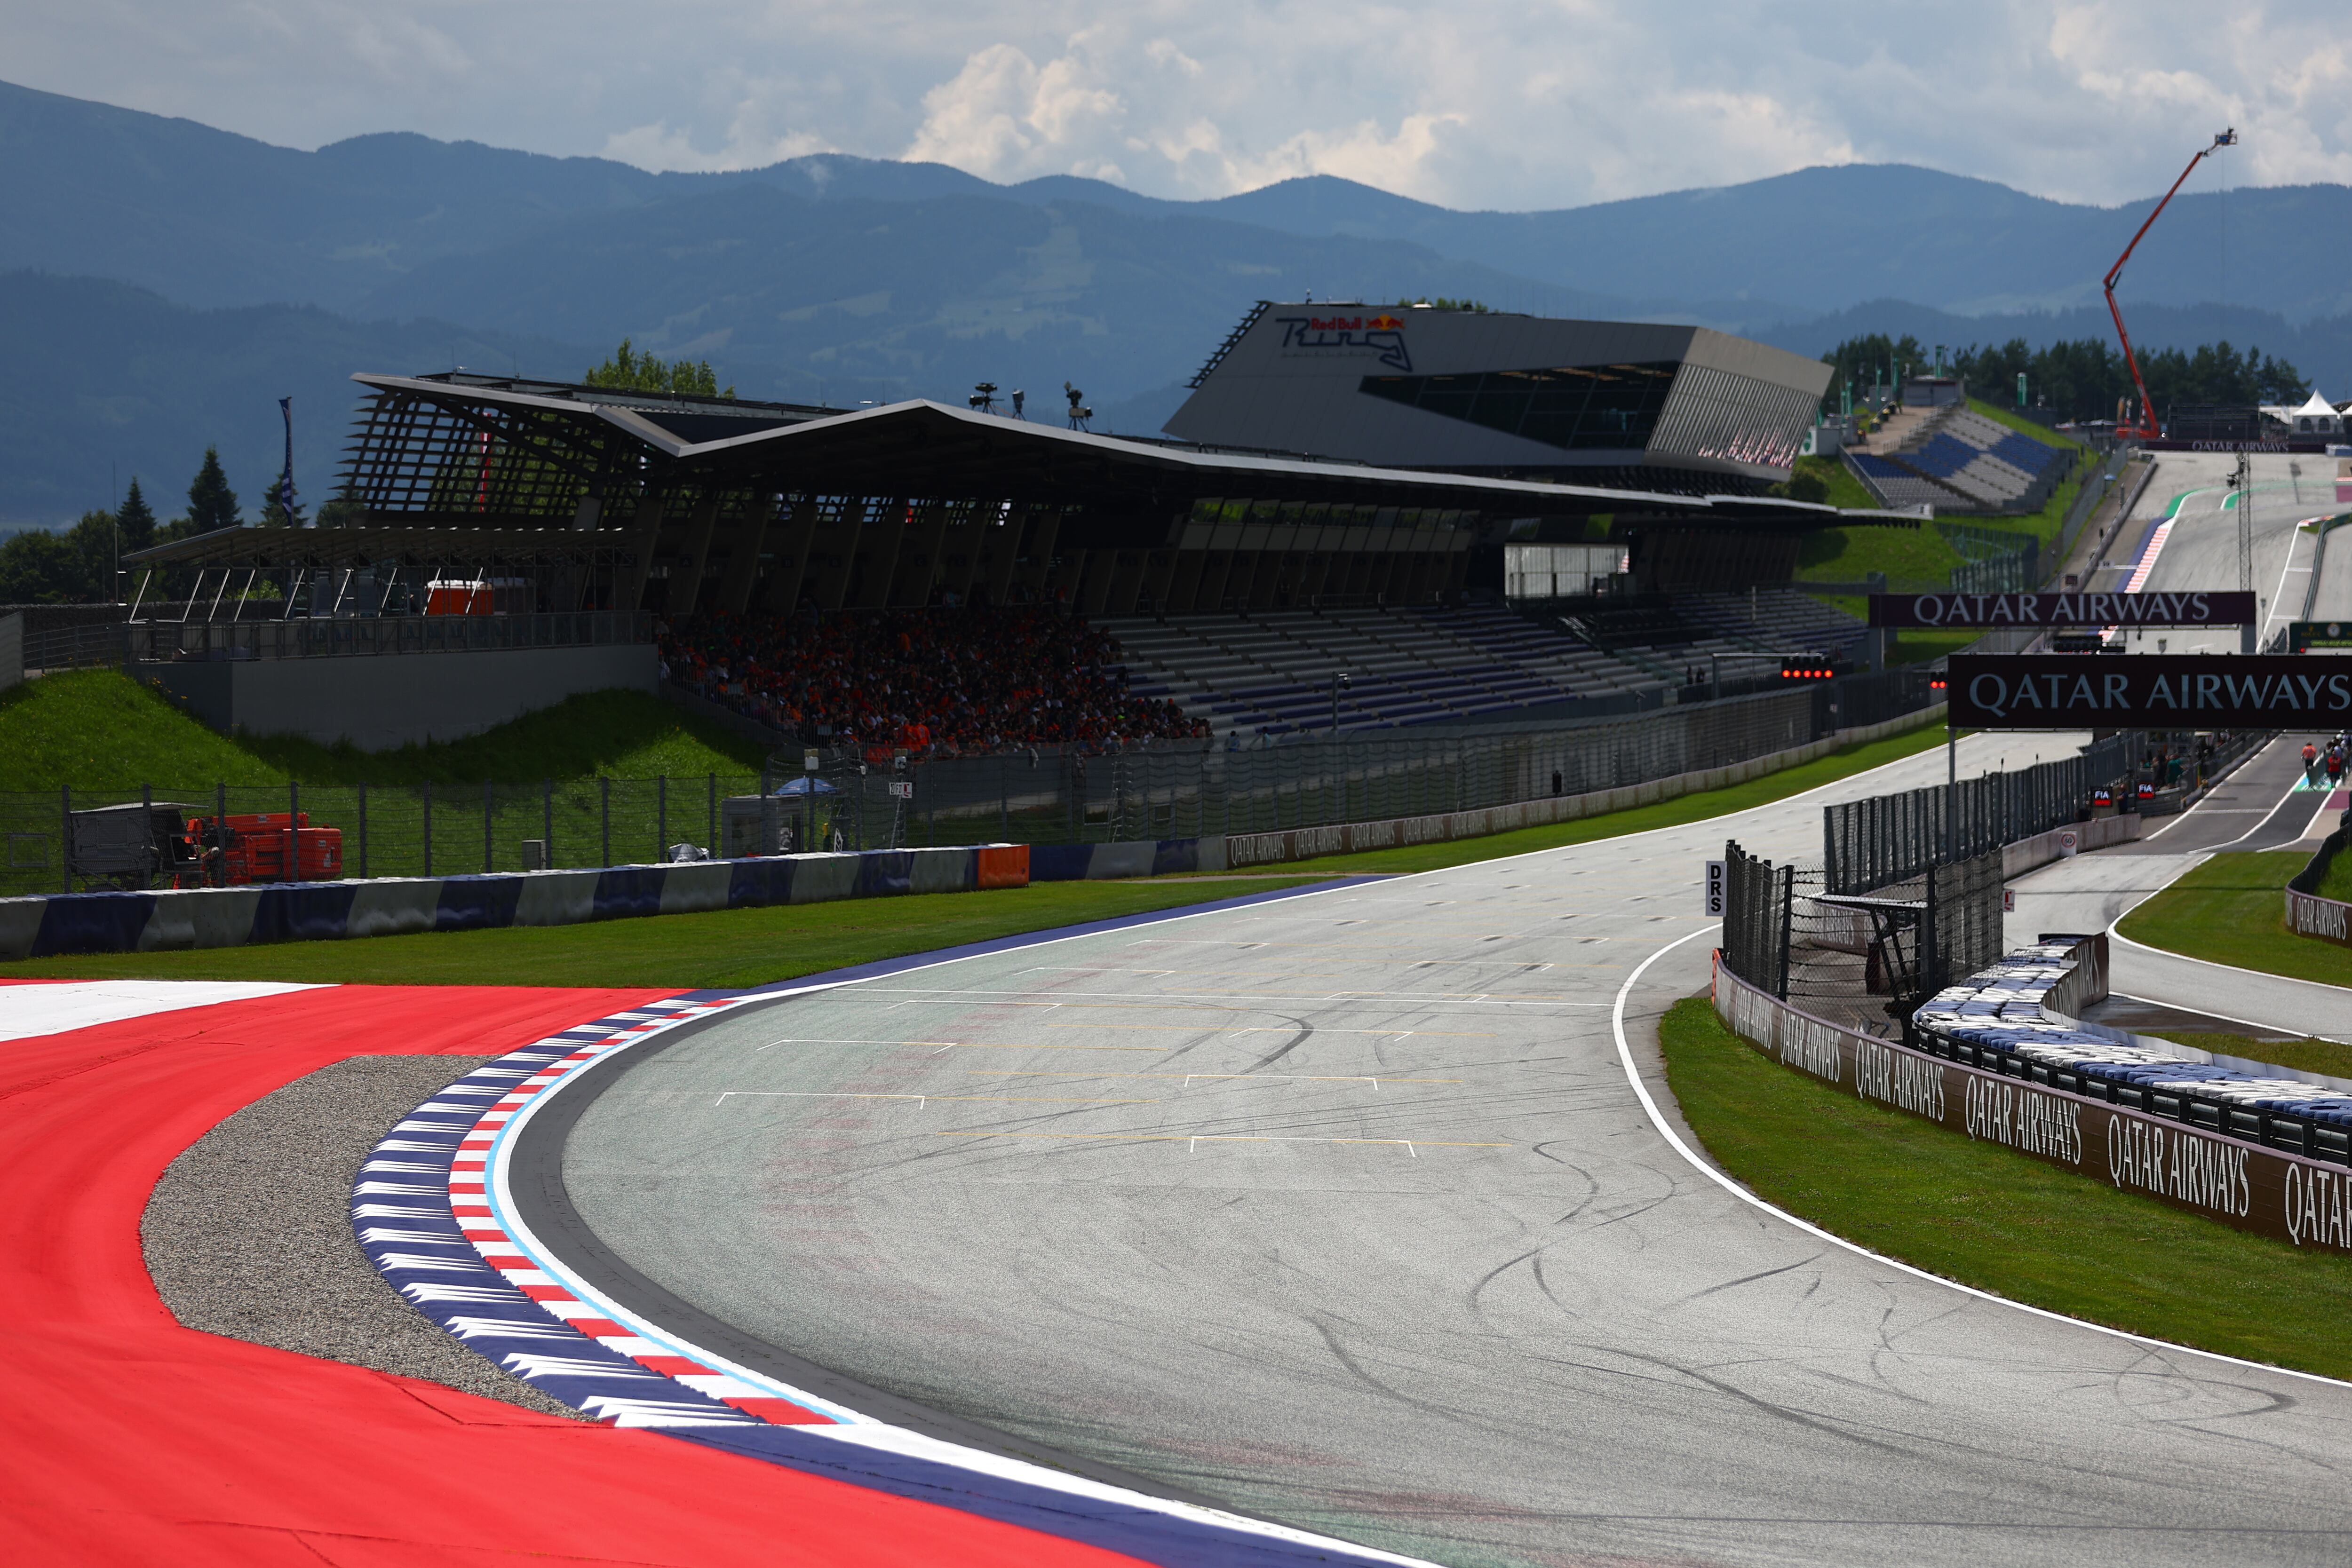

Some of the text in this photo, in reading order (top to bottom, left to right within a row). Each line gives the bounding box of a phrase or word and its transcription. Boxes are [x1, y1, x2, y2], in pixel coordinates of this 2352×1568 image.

[1311, 317, 1361, 330] Red Bull
[2192, 440, 2289, 452] QATAR AIRWAYS
[1914, 594, 2210, 626] QATAR AIRWAYS
[1969, 673, 2352, 718] QATAR AIRWAYS
[2095, 790, 2110, 800] FIA
[2138, 784, 2153, 793] FIA
[1231, 834, 1285, 866] QATAR AIRWAYS
[1294, 826, 1343, 859] QATAR AIRWAYS
[1351, 824, 1370, 852] QATAR
[1710, 864, 1722, 912] DRS
[2296, 896, 2314, 935] QATAR
[2315, 900, 2346, 941] AIRWAYS
[1780, 1009, 1841, 1083] QATAR AIRWAYS
[1856, 1038, 1944, 1122] QATAR AIRWAYS
[1965, 1074, 2082, 1165] QATAR AIRWAYS
[2108, 1114, 2249, 1218] QATAR AIRWAYS
